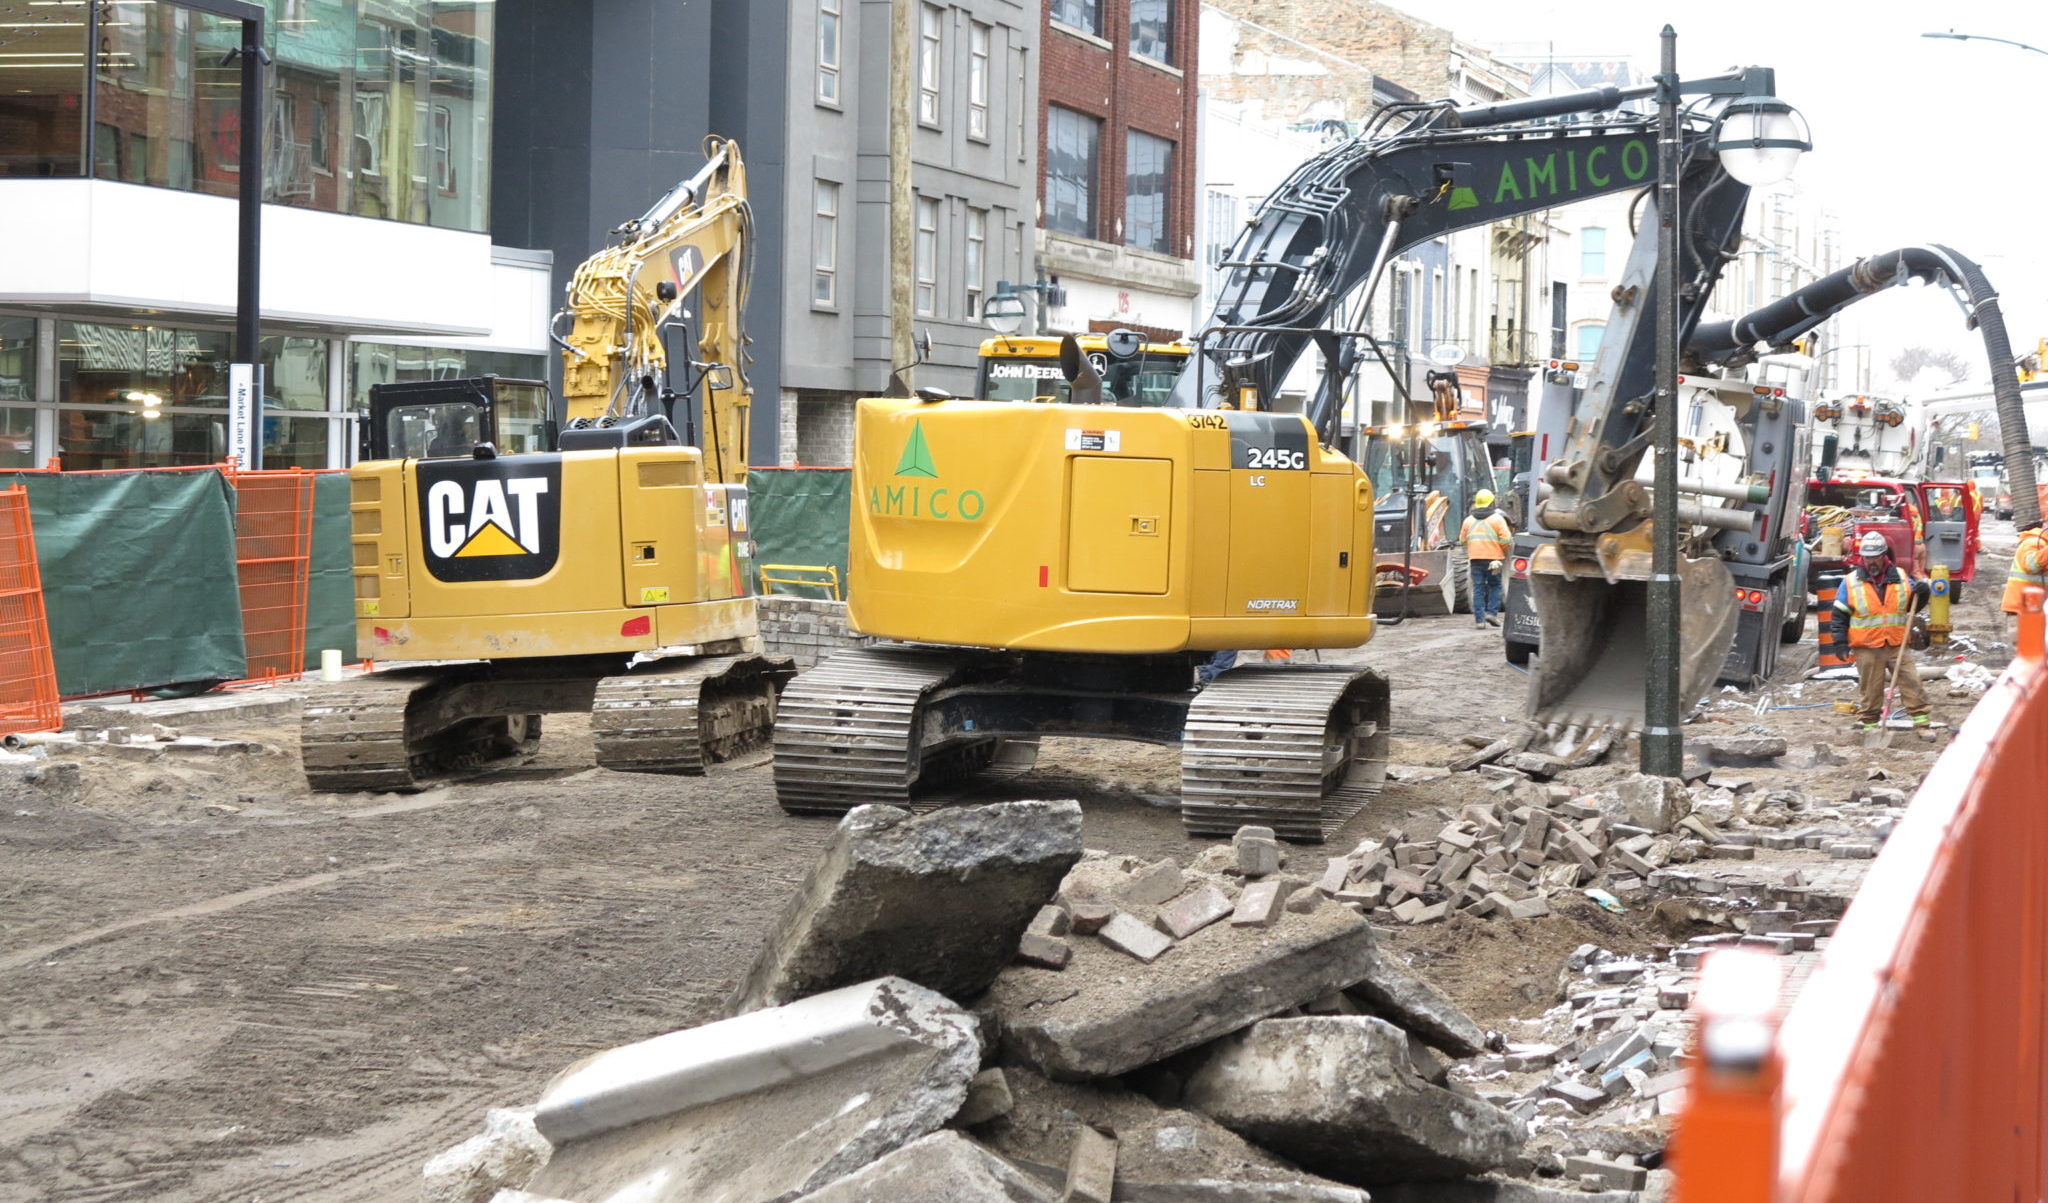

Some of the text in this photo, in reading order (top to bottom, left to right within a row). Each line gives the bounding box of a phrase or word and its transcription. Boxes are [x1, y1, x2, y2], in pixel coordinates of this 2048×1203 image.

[1494, 140, 1649, 204] AMICO
[678, 247, 694, 286] CAT
[989, 363, 1024, 378] JOHN
[237, 388, 247, 419] Market
[236, 422, 246, 445] Lane
[1189, 414, 1228, 430] 3742
[1247, 448, 1305, 470] 245G
[1250, 475, 1265, 487] LC
[731, 499, 747, 532] CAT
[869, 485, 985, 520] AMICO
[428, 477, 548, 558] CAT
[1247, 599, 1298, 609] NORTRAX
